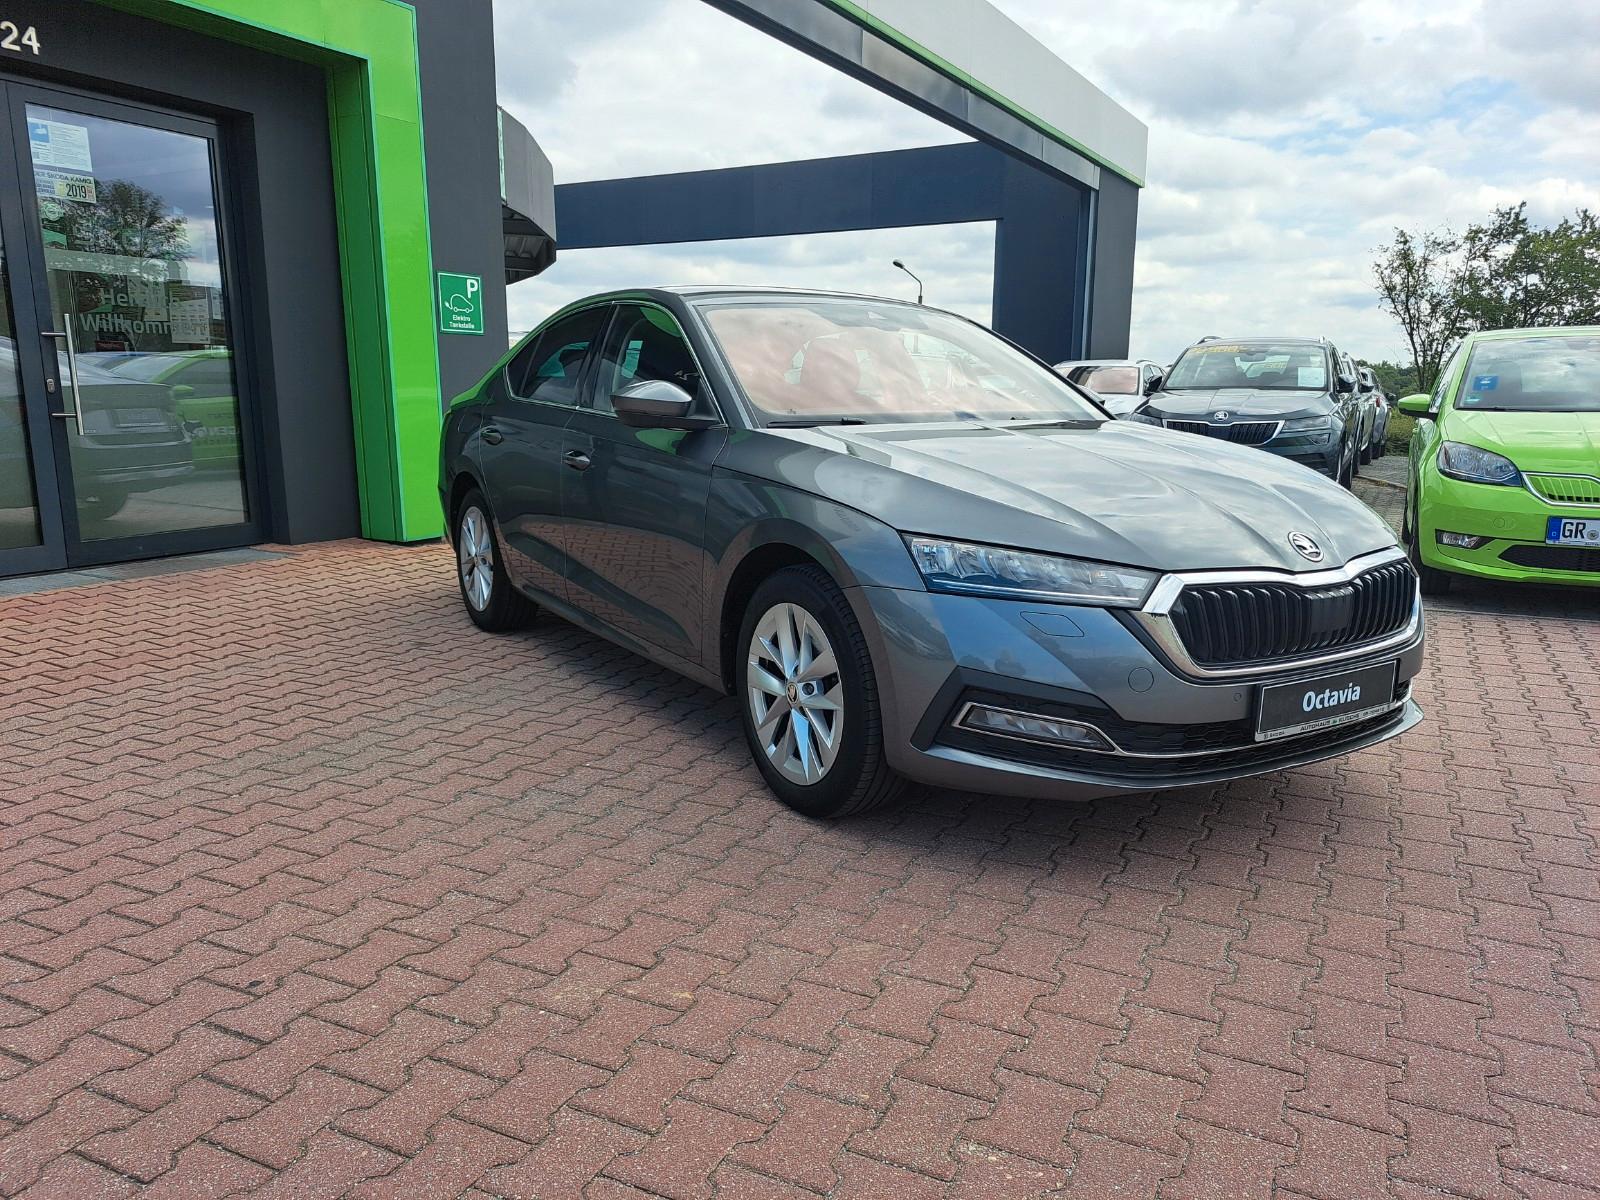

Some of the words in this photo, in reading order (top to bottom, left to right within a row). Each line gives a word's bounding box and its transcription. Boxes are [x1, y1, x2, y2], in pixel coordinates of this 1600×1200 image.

[0, 20, 41, 55] 24
[66, 183, 87, 198] 2019
[466, 279, 478, 298] P
[1562, 522, 1586, 539] GR
[1303, 683, 1360, 711] Octavia
